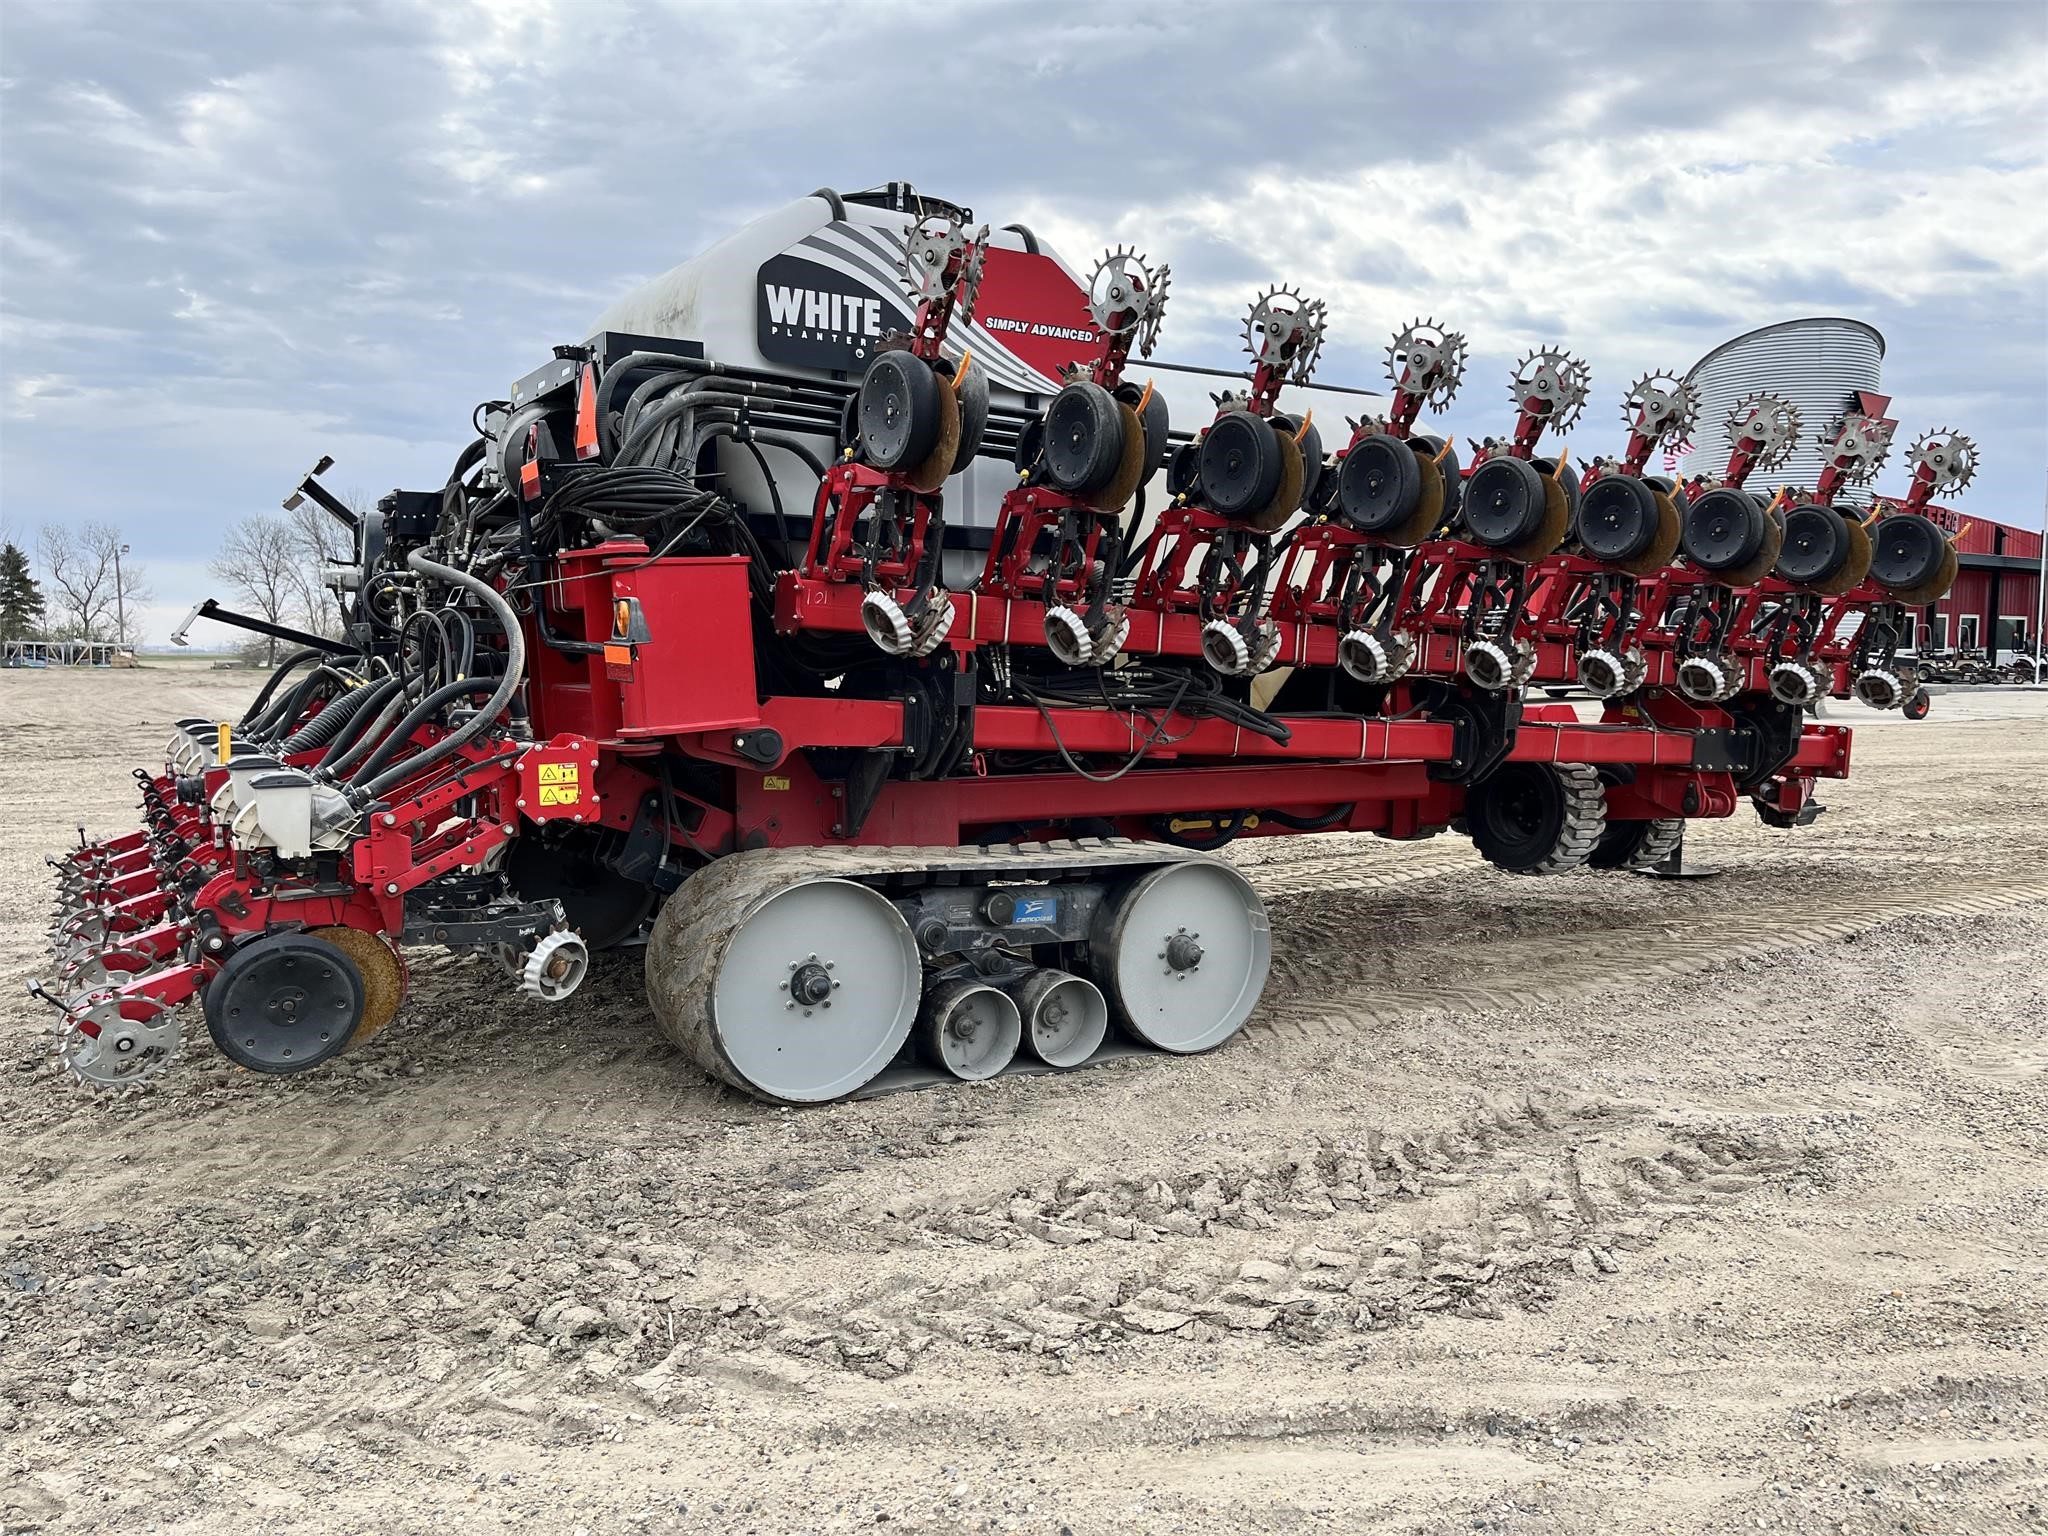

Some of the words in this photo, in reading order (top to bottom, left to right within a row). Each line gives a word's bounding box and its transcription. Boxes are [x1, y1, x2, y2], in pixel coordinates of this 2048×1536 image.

[765, 284, 881, 336] WHITE
[985, 317, 1029, 334] SIMPLY
[1031, 325, 1093, 342] ADVANCED
